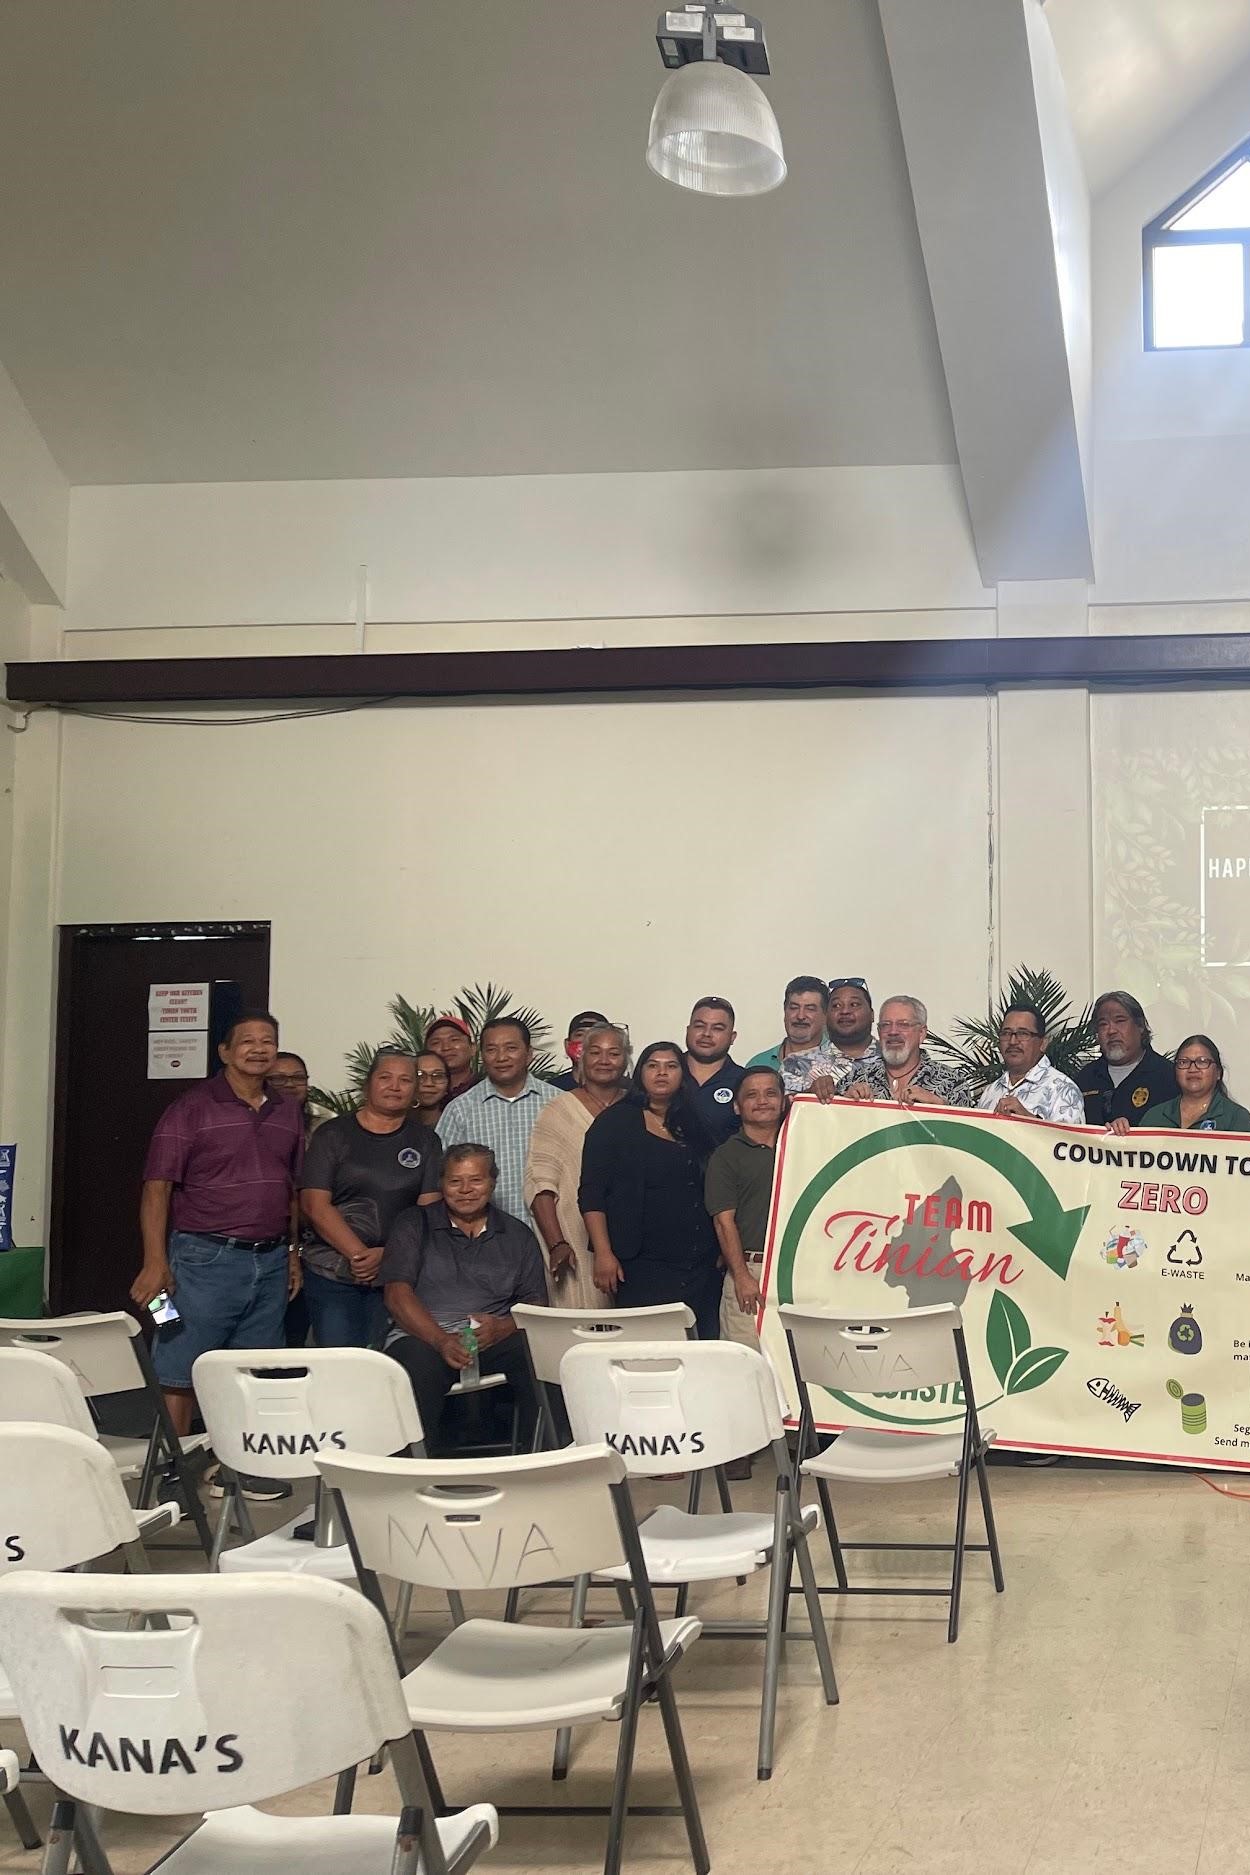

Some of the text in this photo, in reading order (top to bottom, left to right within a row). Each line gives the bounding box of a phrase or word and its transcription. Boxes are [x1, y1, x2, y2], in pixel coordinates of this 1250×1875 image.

[1053, 1142, 1218, 1174] COUNTDOWN
[904, 1193, 993, 1233] TEAM
[1117, 1180, 1209, 1215] ZERO
[823, 1210, 1025, 1285] Tinian
[1161, 1268, 1205, 1280] E-WASTE
[1233, 1340, 1246, 1348] Be
[242, 1431, 347, 1456] KANA'S
[605, 1431, 705, 1456] KANA'S
[1214, 1436, 1238, 1447] Send
[388, 1513, 560, 1586] MVA
[58, 1724, 245, 1775] KANA'S
